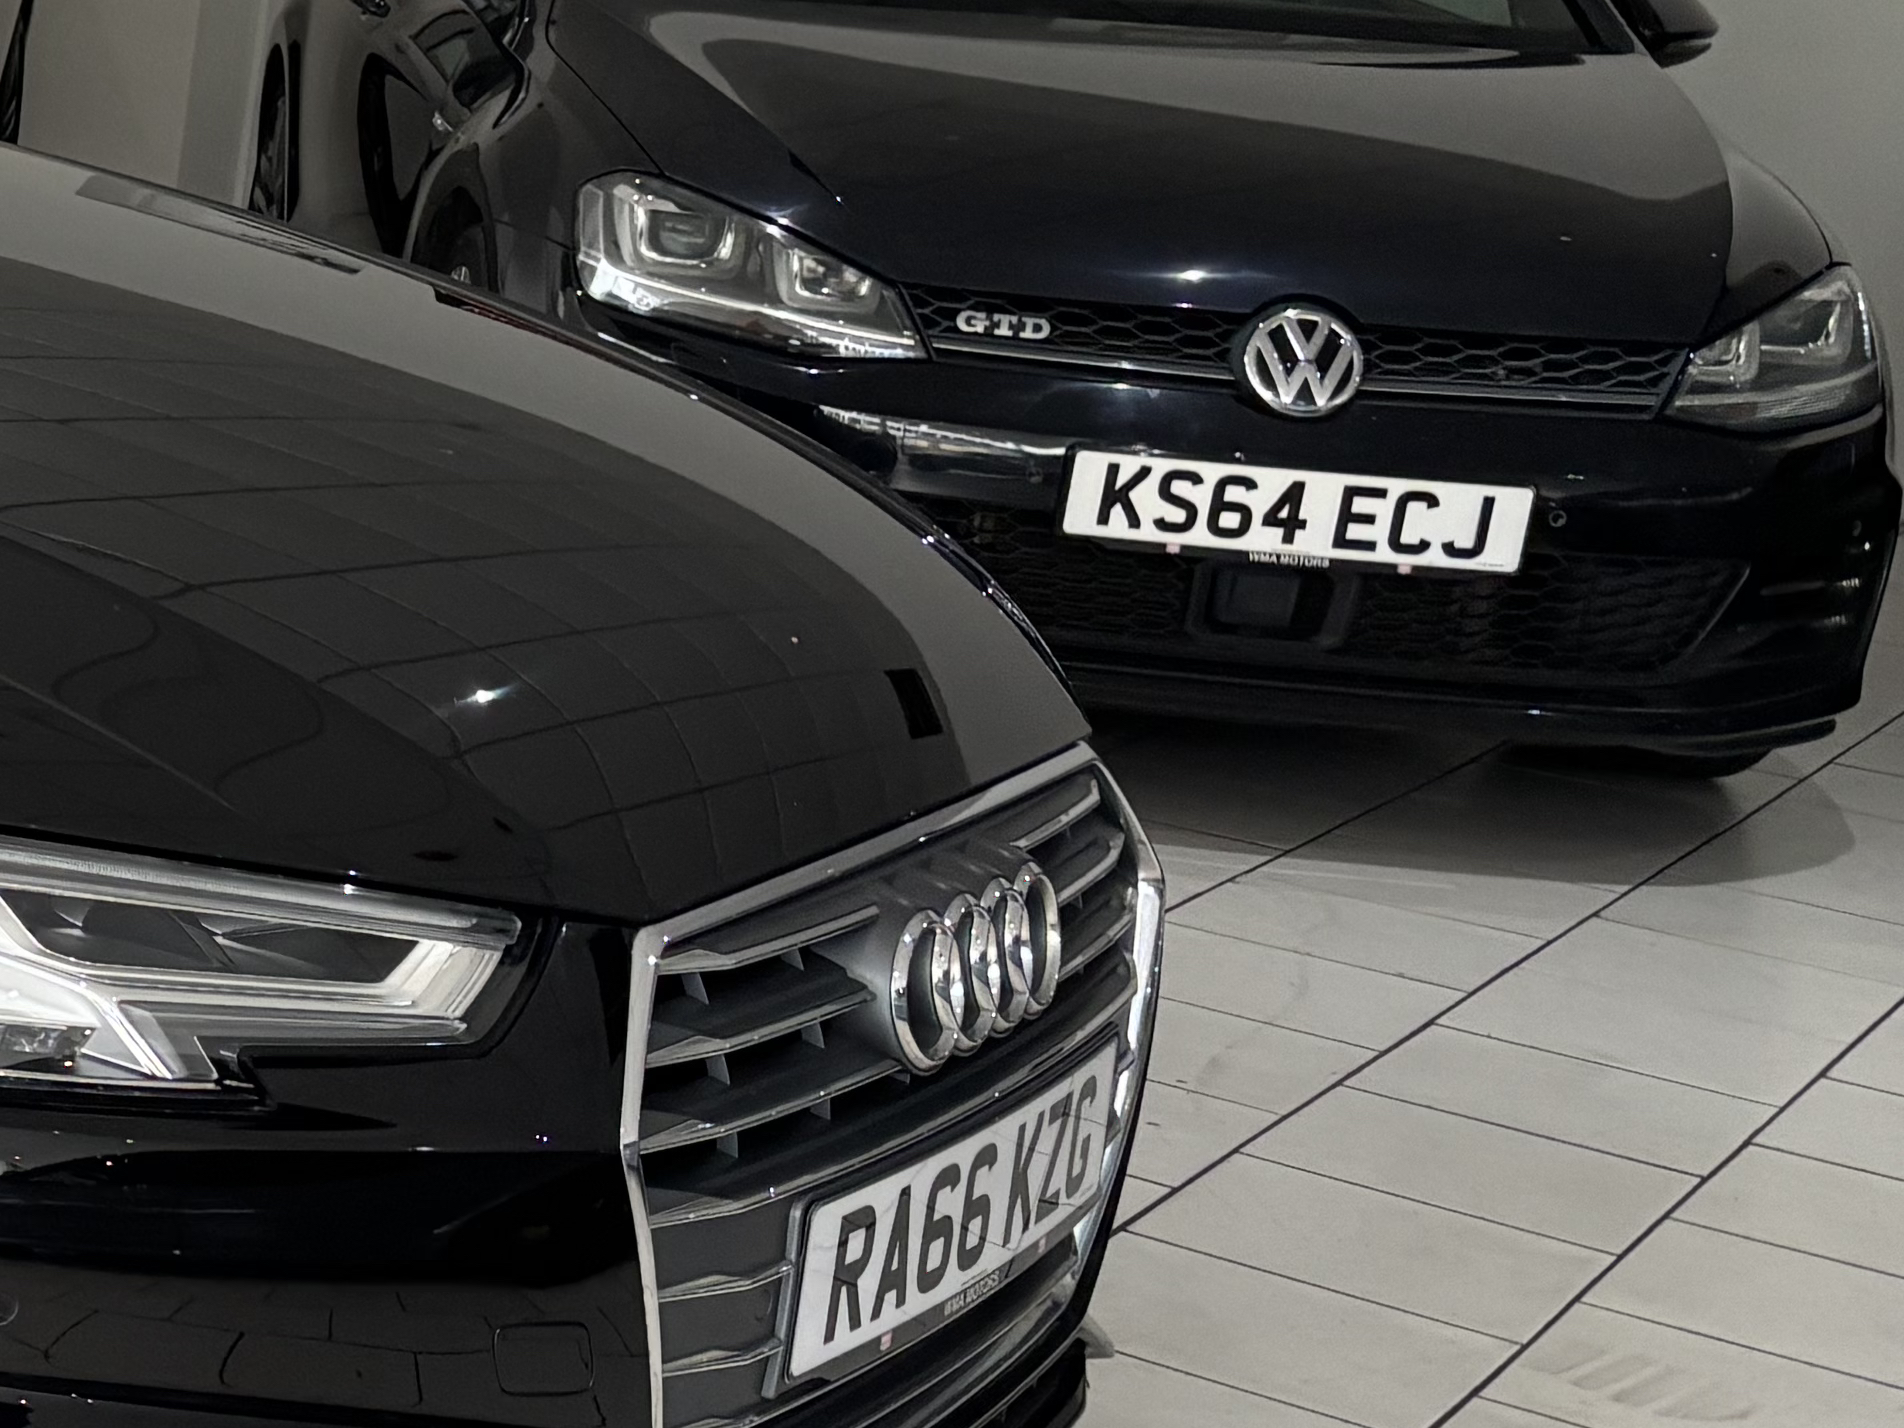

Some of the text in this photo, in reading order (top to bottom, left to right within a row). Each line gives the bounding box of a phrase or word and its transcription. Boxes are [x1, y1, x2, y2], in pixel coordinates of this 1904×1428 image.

[956, 310, 1051, 340] GTD
[1096, 462, 1496, 560] KS64 ECJ
[823, 1075, 1097, 1346] RA66 KZG
